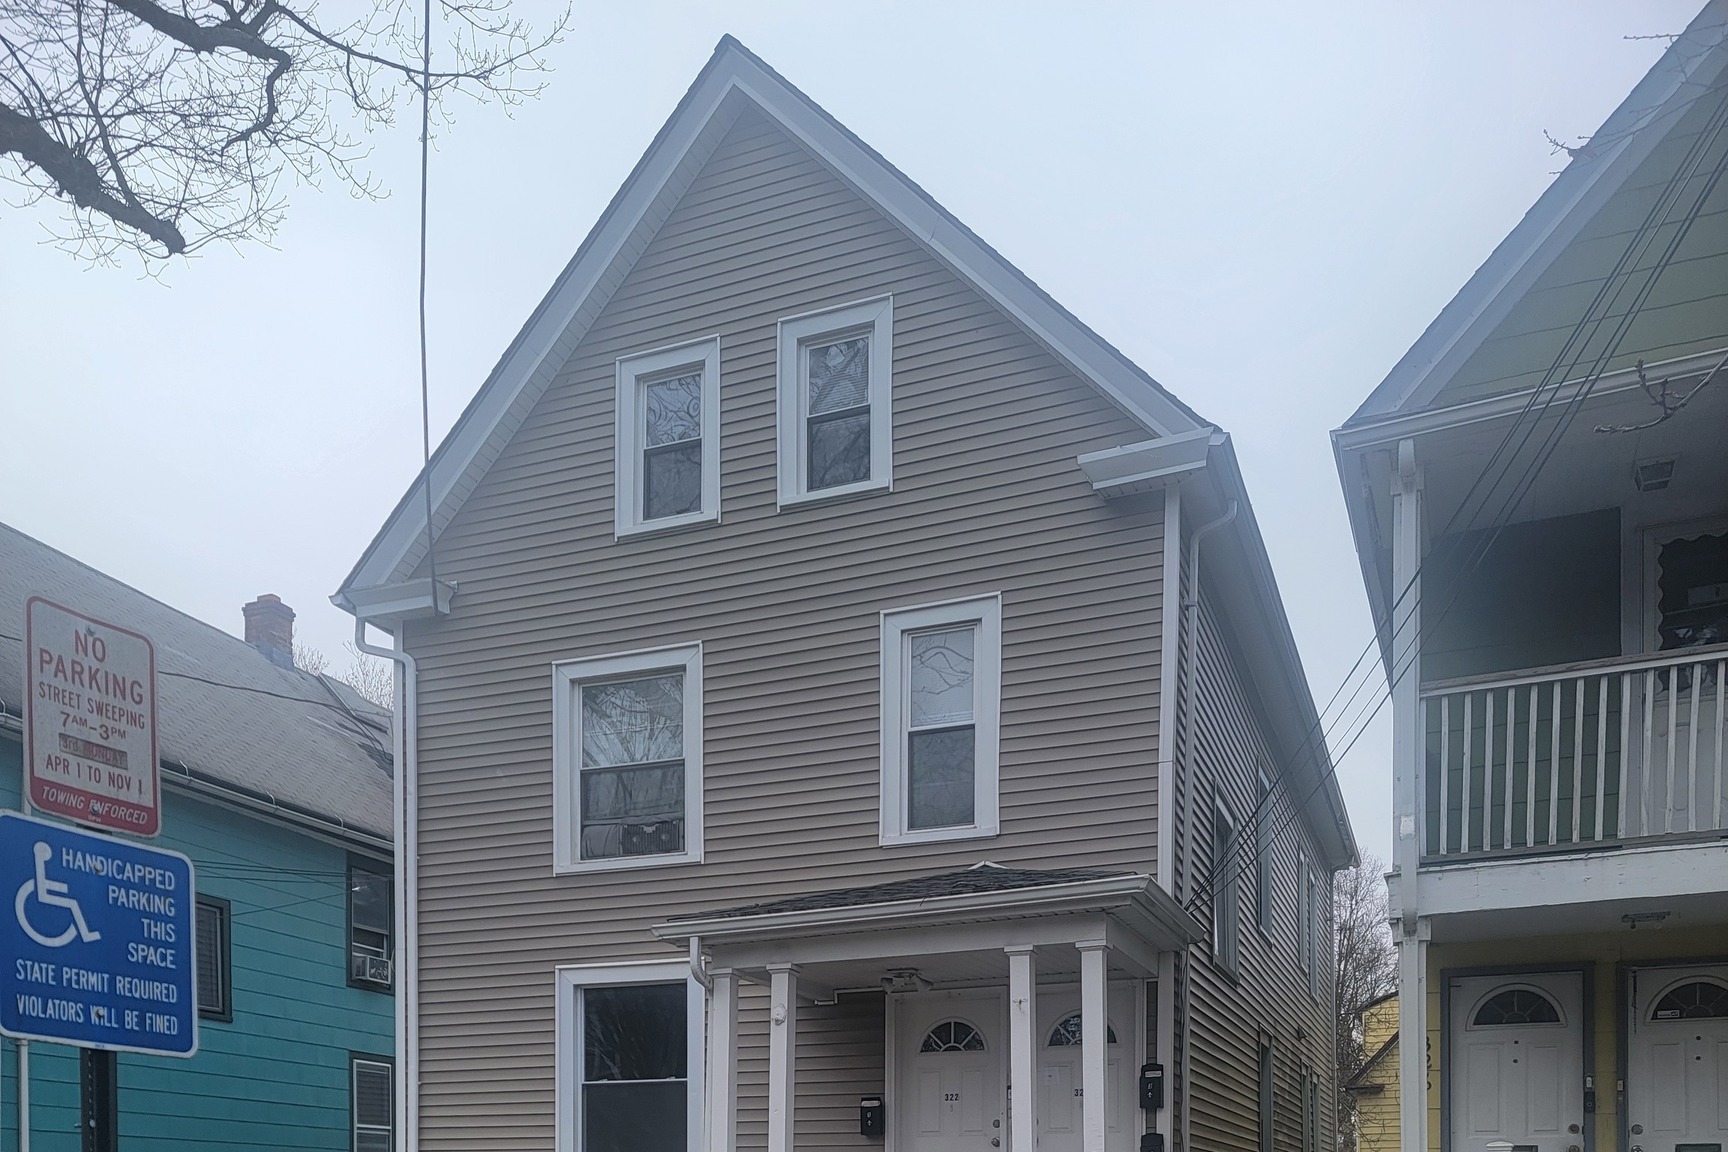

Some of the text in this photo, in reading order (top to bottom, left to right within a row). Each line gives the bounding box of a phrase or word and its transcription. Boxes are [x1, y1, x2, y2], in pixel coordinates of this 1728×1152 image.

[75, 629, 106, 663] NO
[39, 648, 144, 705] PARKING
[39, 682, 145, 730] STREET SWEEPING
[83, 743, 124, 765] MONDAY
[46, 754, 142, 795] APR 1 TO NOV 1
[42, 786, 148, 825] TOWING ENFORCED
[62, 847, 175, 890] HANDICAPPED
[108, 885, 175, 917] PARKING
[141, 918, 176, 943] THIS
[127, 942, 176, 969] SPACE
[15, 958, 177, 1004] STATE PERMIT REQUIRED
[16, 994, 84, 1024] VIOLATORS
[124, 1010, 139, 1031] BE
[146, 1013, 178, 1035] FINED
[944, 1093, 959, 1102] 322
[1074, 1088, 1084, 1097] 32
